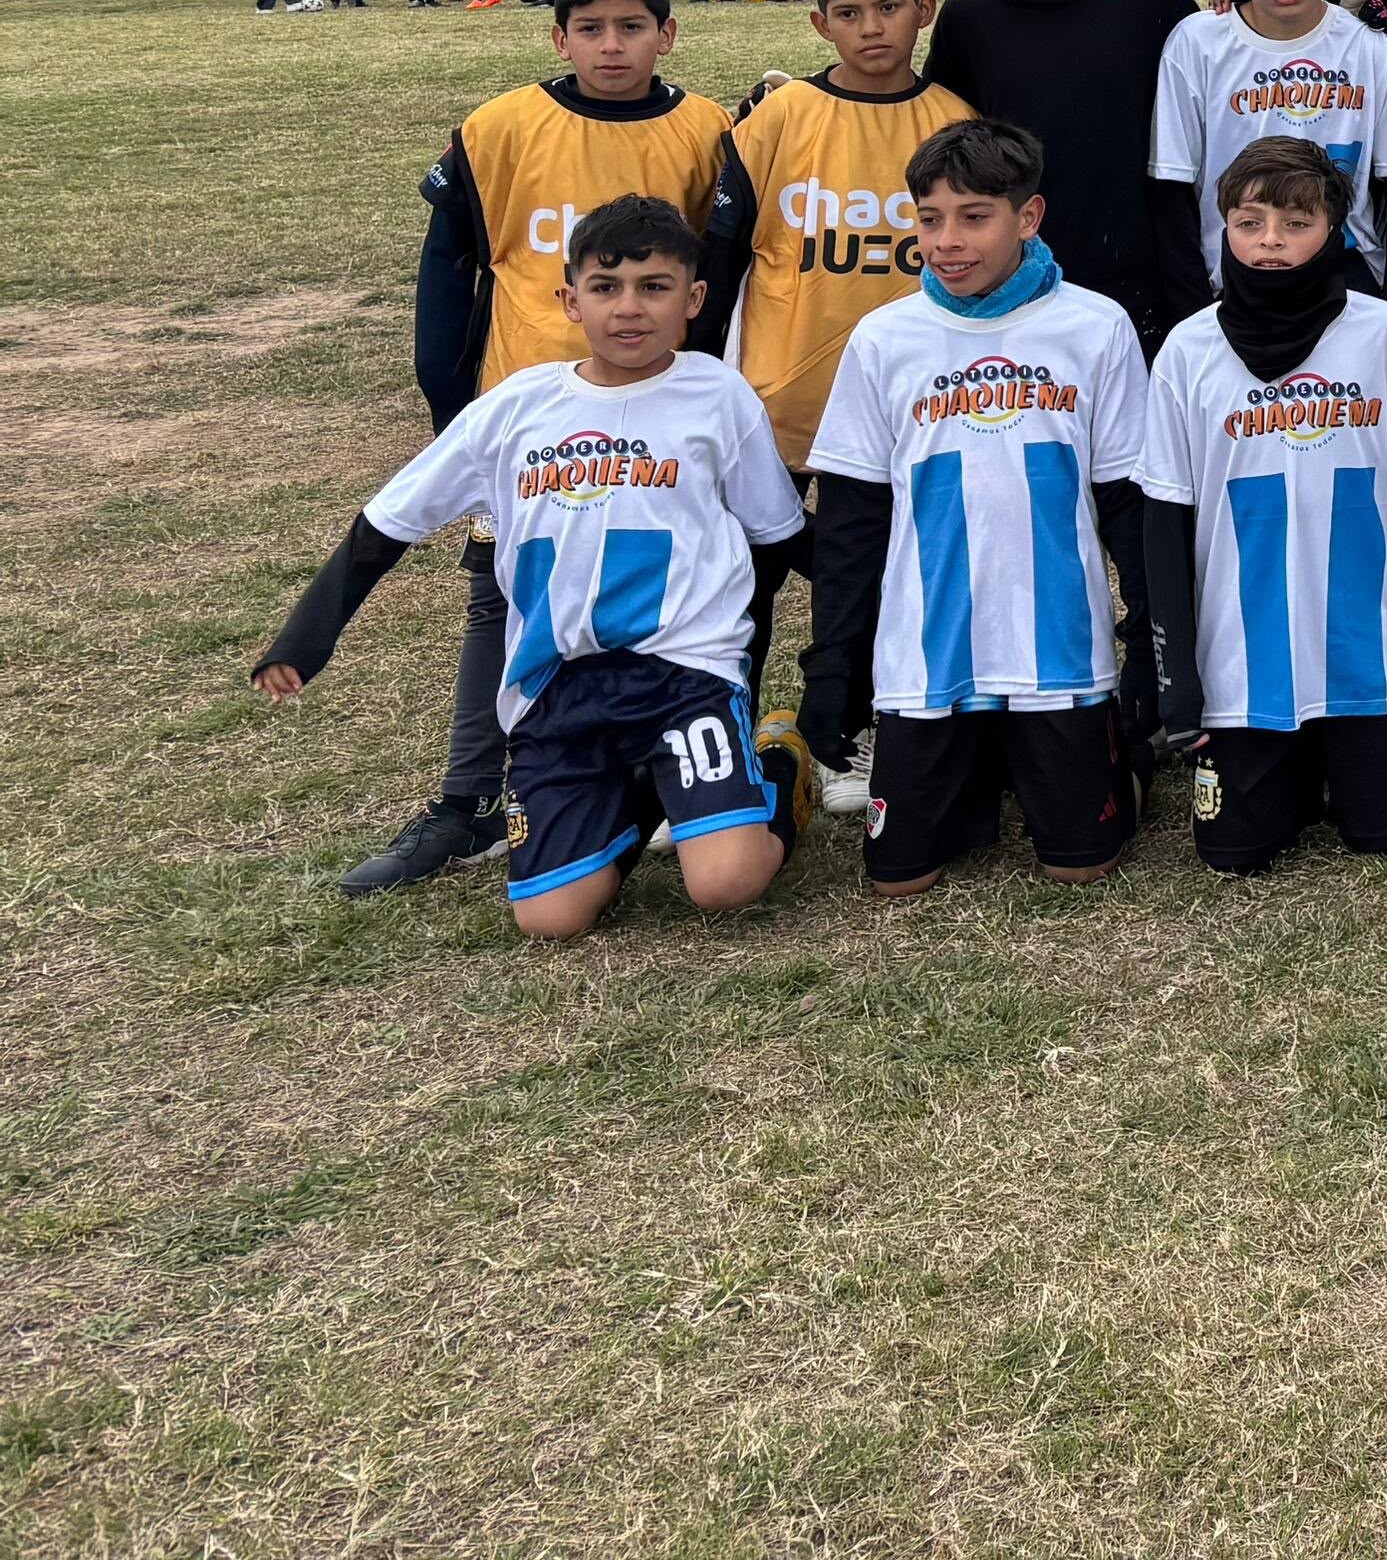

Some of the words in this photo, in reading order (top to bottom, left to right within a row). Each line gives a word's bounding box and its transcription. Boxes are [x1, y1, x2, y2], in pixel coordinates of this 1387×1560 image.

[1253, 67, 1349, 85] LOTERIA
[933, 365, 1050, 391] LOTERIA
[1247, 382, 1362, 405] LOTERIA
[527, 438, 648, 465] LOTERIA
[662, 716, 733, 789] 10
